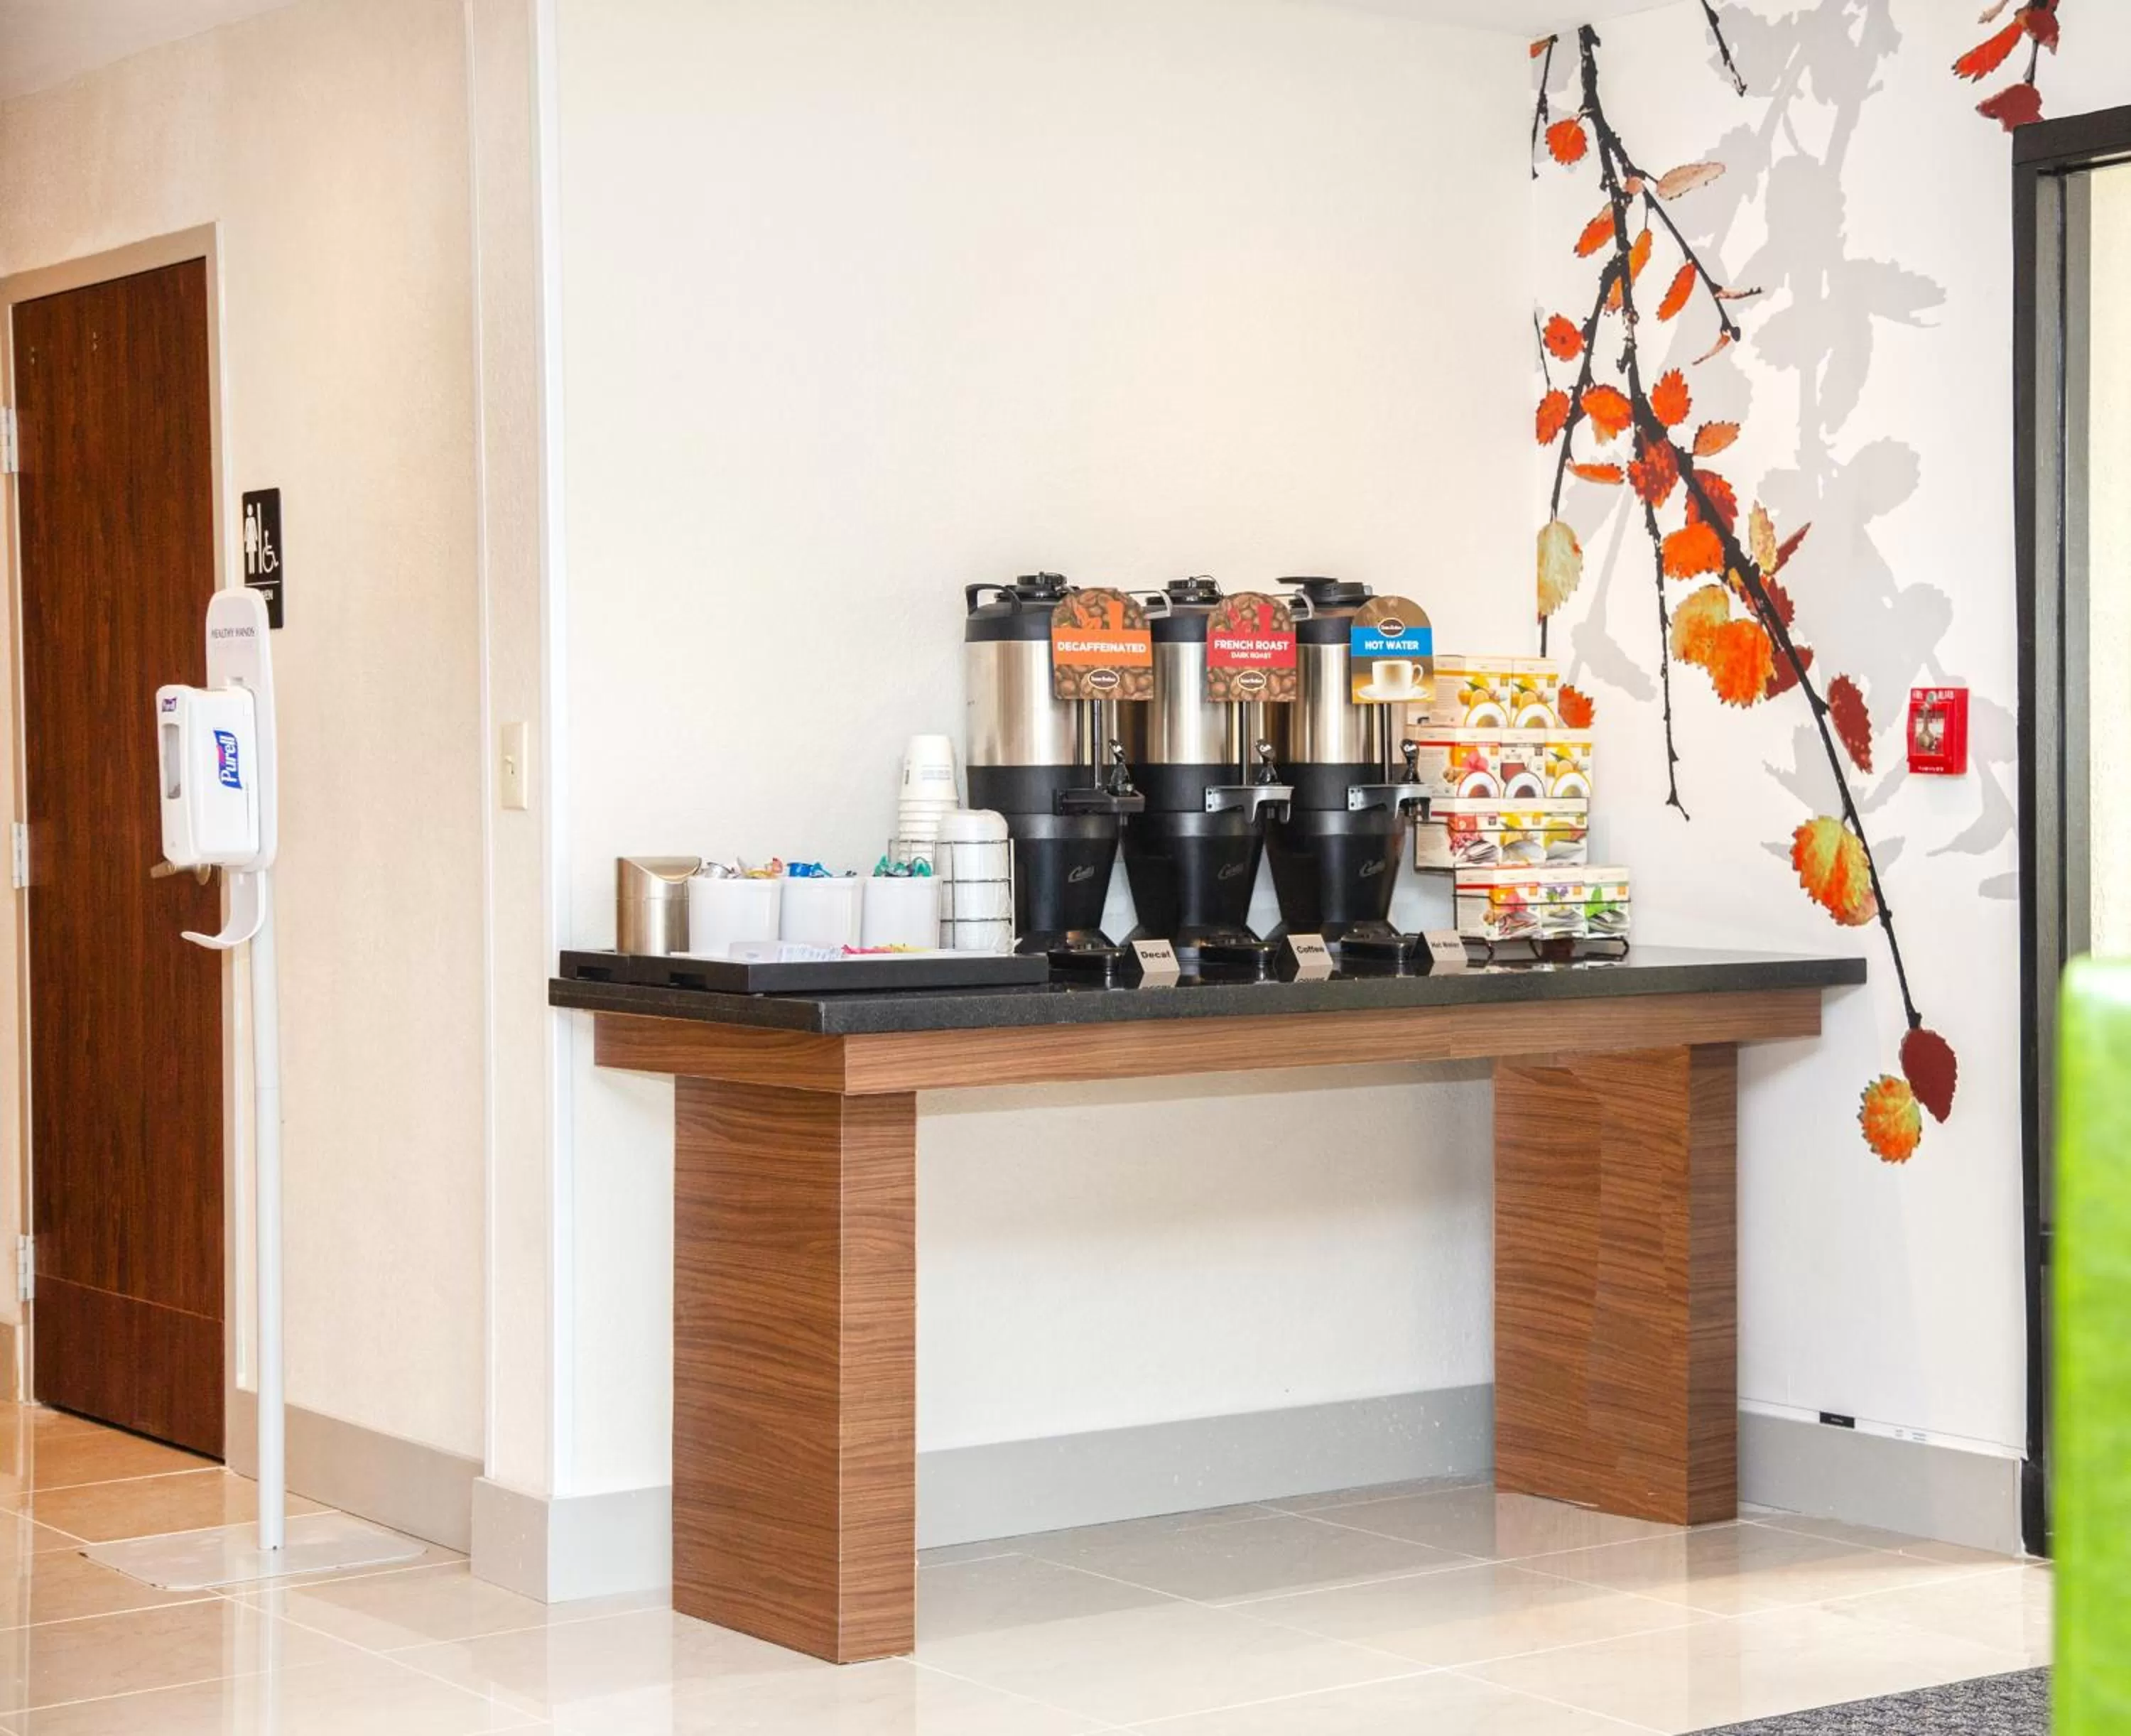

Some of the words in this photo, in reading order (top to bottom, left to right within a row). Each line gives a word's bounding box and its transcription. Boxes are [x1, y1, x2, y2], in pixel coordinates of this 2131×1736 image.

[1057, 641, 1146, 653] DECAFFEINATED
[1214, 640, 1254, 650] FRENCH
[1255, 641, 1289, 651] ROAST
[1365, 641, 1384, 650] HOT
[1386, 640, 1419, 650] WATER
[219, 735, 237, 783] Purell
